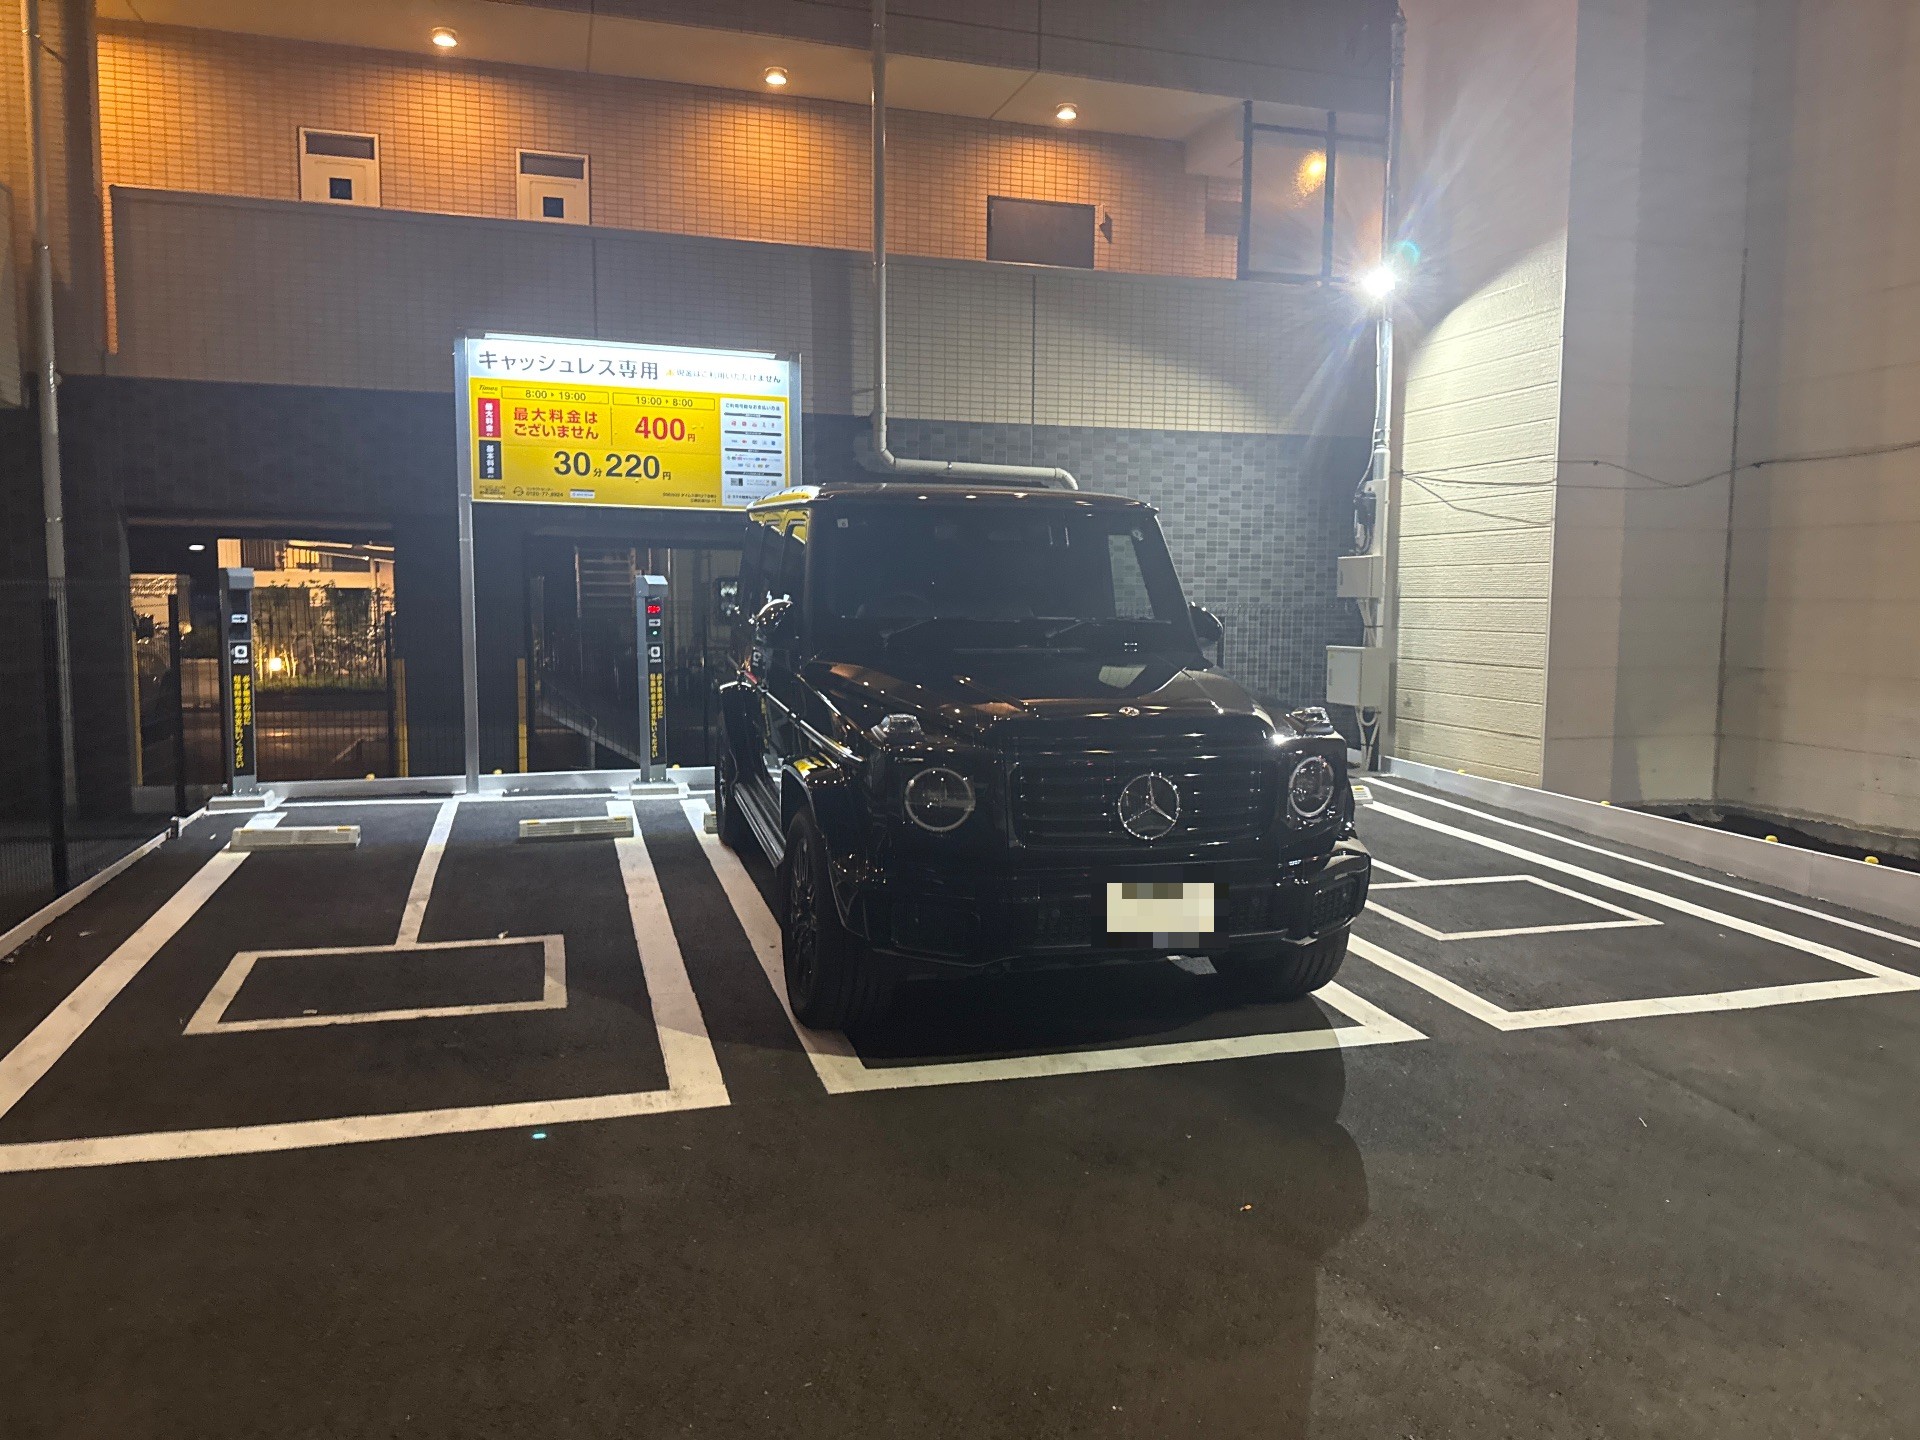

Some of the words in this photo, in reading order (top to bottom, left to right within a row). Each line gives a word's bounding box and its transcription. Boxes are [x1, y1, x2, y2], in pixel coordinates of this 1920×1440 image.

[478, 350, 658, 380] キャッシュレス専用
[525, 389, 547, 399] 8:00
[559, 391, 587, 401] 19:00
[636, 396, 662, 406] 19:00
[673, 398, 693, 408] 8:00
[514, 406, 598, 424] 最大料金は
[514, 423, 599, 440] ございません
